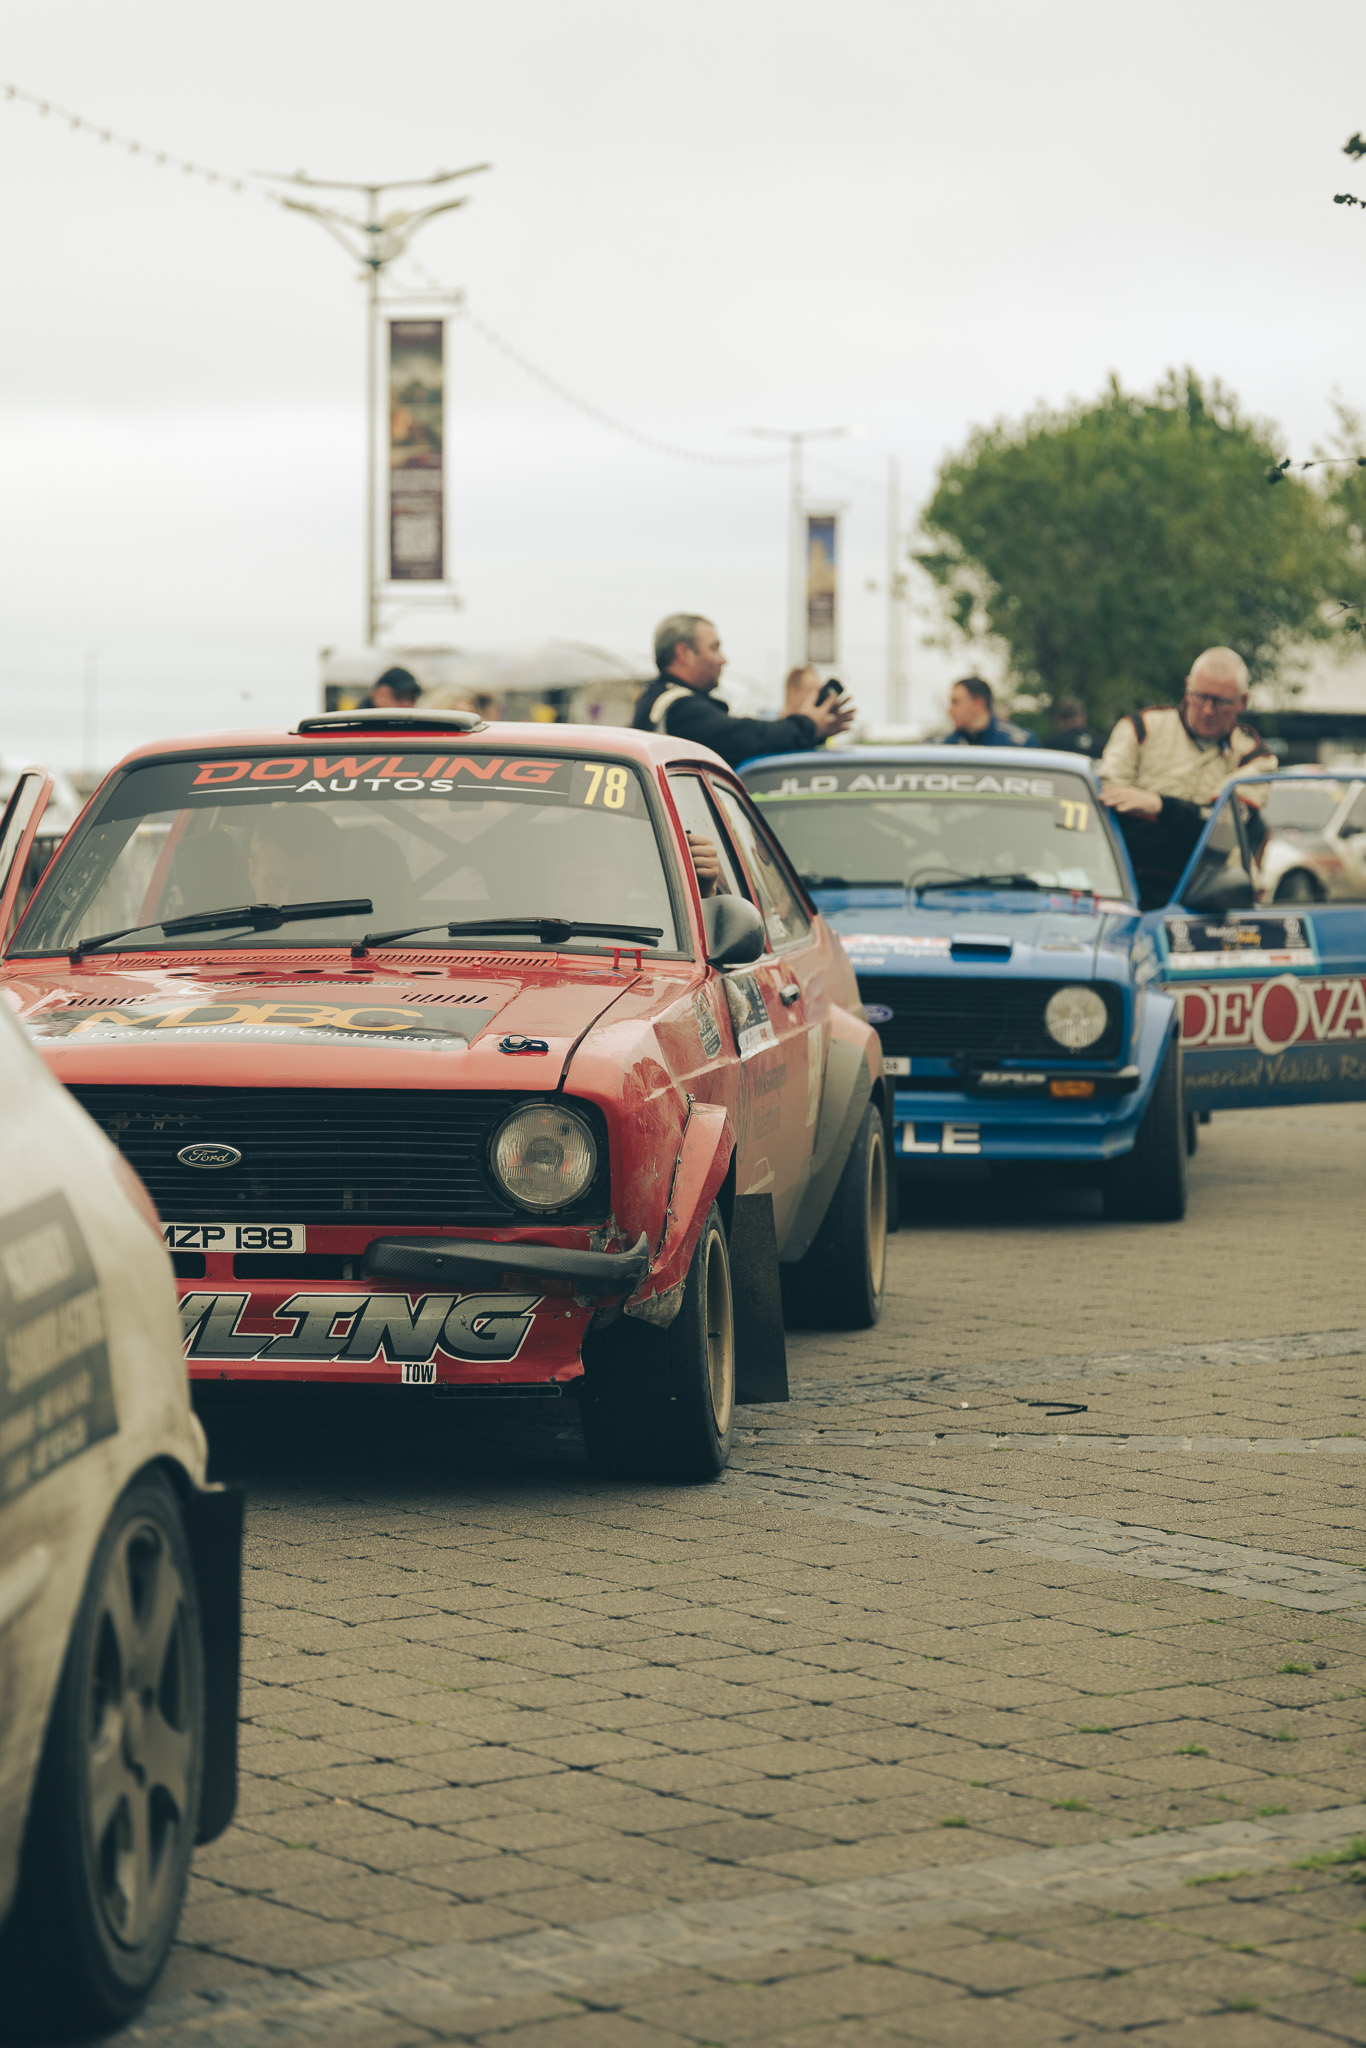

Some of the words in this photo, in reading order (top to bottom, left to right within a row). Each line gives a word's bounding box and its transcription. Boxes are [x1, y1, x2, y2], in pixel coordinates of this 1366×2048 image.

[192, 756, 564, 786] DOWLING
[295, 778, 454, 793] AUTOS
[582, 764, 627, 810] 78
[848, 773, 1054, 798] AUTOCARE
[67, 1003, 424, 1034] MDBC
[175, 1027, 286, 1037] Building
[298, 1029, 454, 1044] Contractors
[188, 1149, 230, 1162] Ford
[236, 1226, 293, 1250] 138
[404, 1364, 434, 1383] TOW
